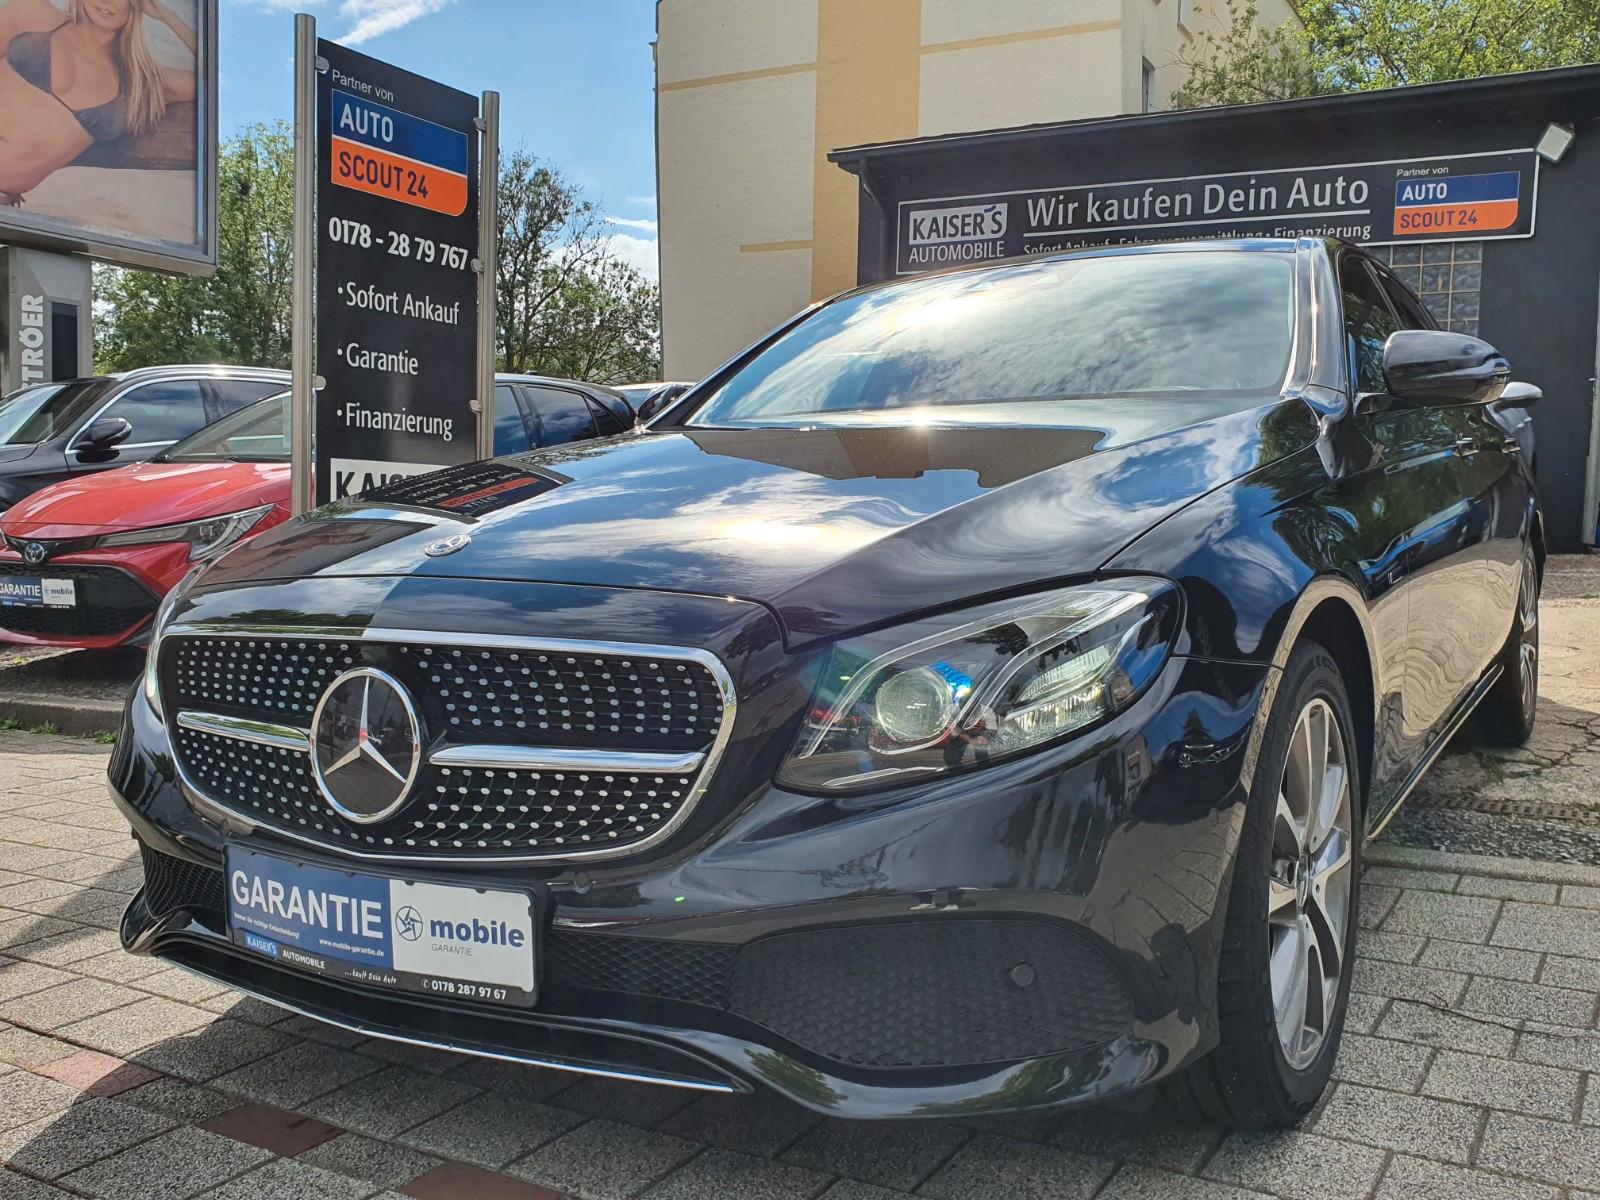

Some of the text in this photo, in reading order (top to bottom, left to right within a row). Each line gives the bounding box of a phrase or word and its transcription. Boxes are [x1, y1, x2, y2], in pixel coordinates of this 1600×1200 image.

[332, 69, 394, 102] Partner von
[339, 103, 394, 143] AUTO
[1396, 166, 1449, 178] Partner von
[1401, 182, 1448, 201] AUTO
[1027, 176, 1369, 227] Wir kaufen Dein Auto
[328, 216, 371, 248] 0178
[387, 231, 410, 257] 28
[414, 237, 435, 263] 79
[439, 243, 469, 270] 767
[1274, 223, 1372, 240] Finanzierung
[908, 241, 1005, 264] AUTOMOBILE
[346, 281, 459, 325] Sofort Ankauf
[19, 294, 44, 388] TRÖER
[346, 342, 419, 376] Garantie
[345, 402, 453, 441] Finanzierung
[231, 870, 525, 948] GARANTIE mobile
[431, 943, 473, 956] GARANTIE
[282, 949, 326, 969] AUTOMOBILE
[383, 974, 397, 984] Auto
[431, 980, 455, 993] 0178
[457, 983, 476, 996] 287
[479, 986, 492, 998] 97
[493, 988, 507, 1000] 67
